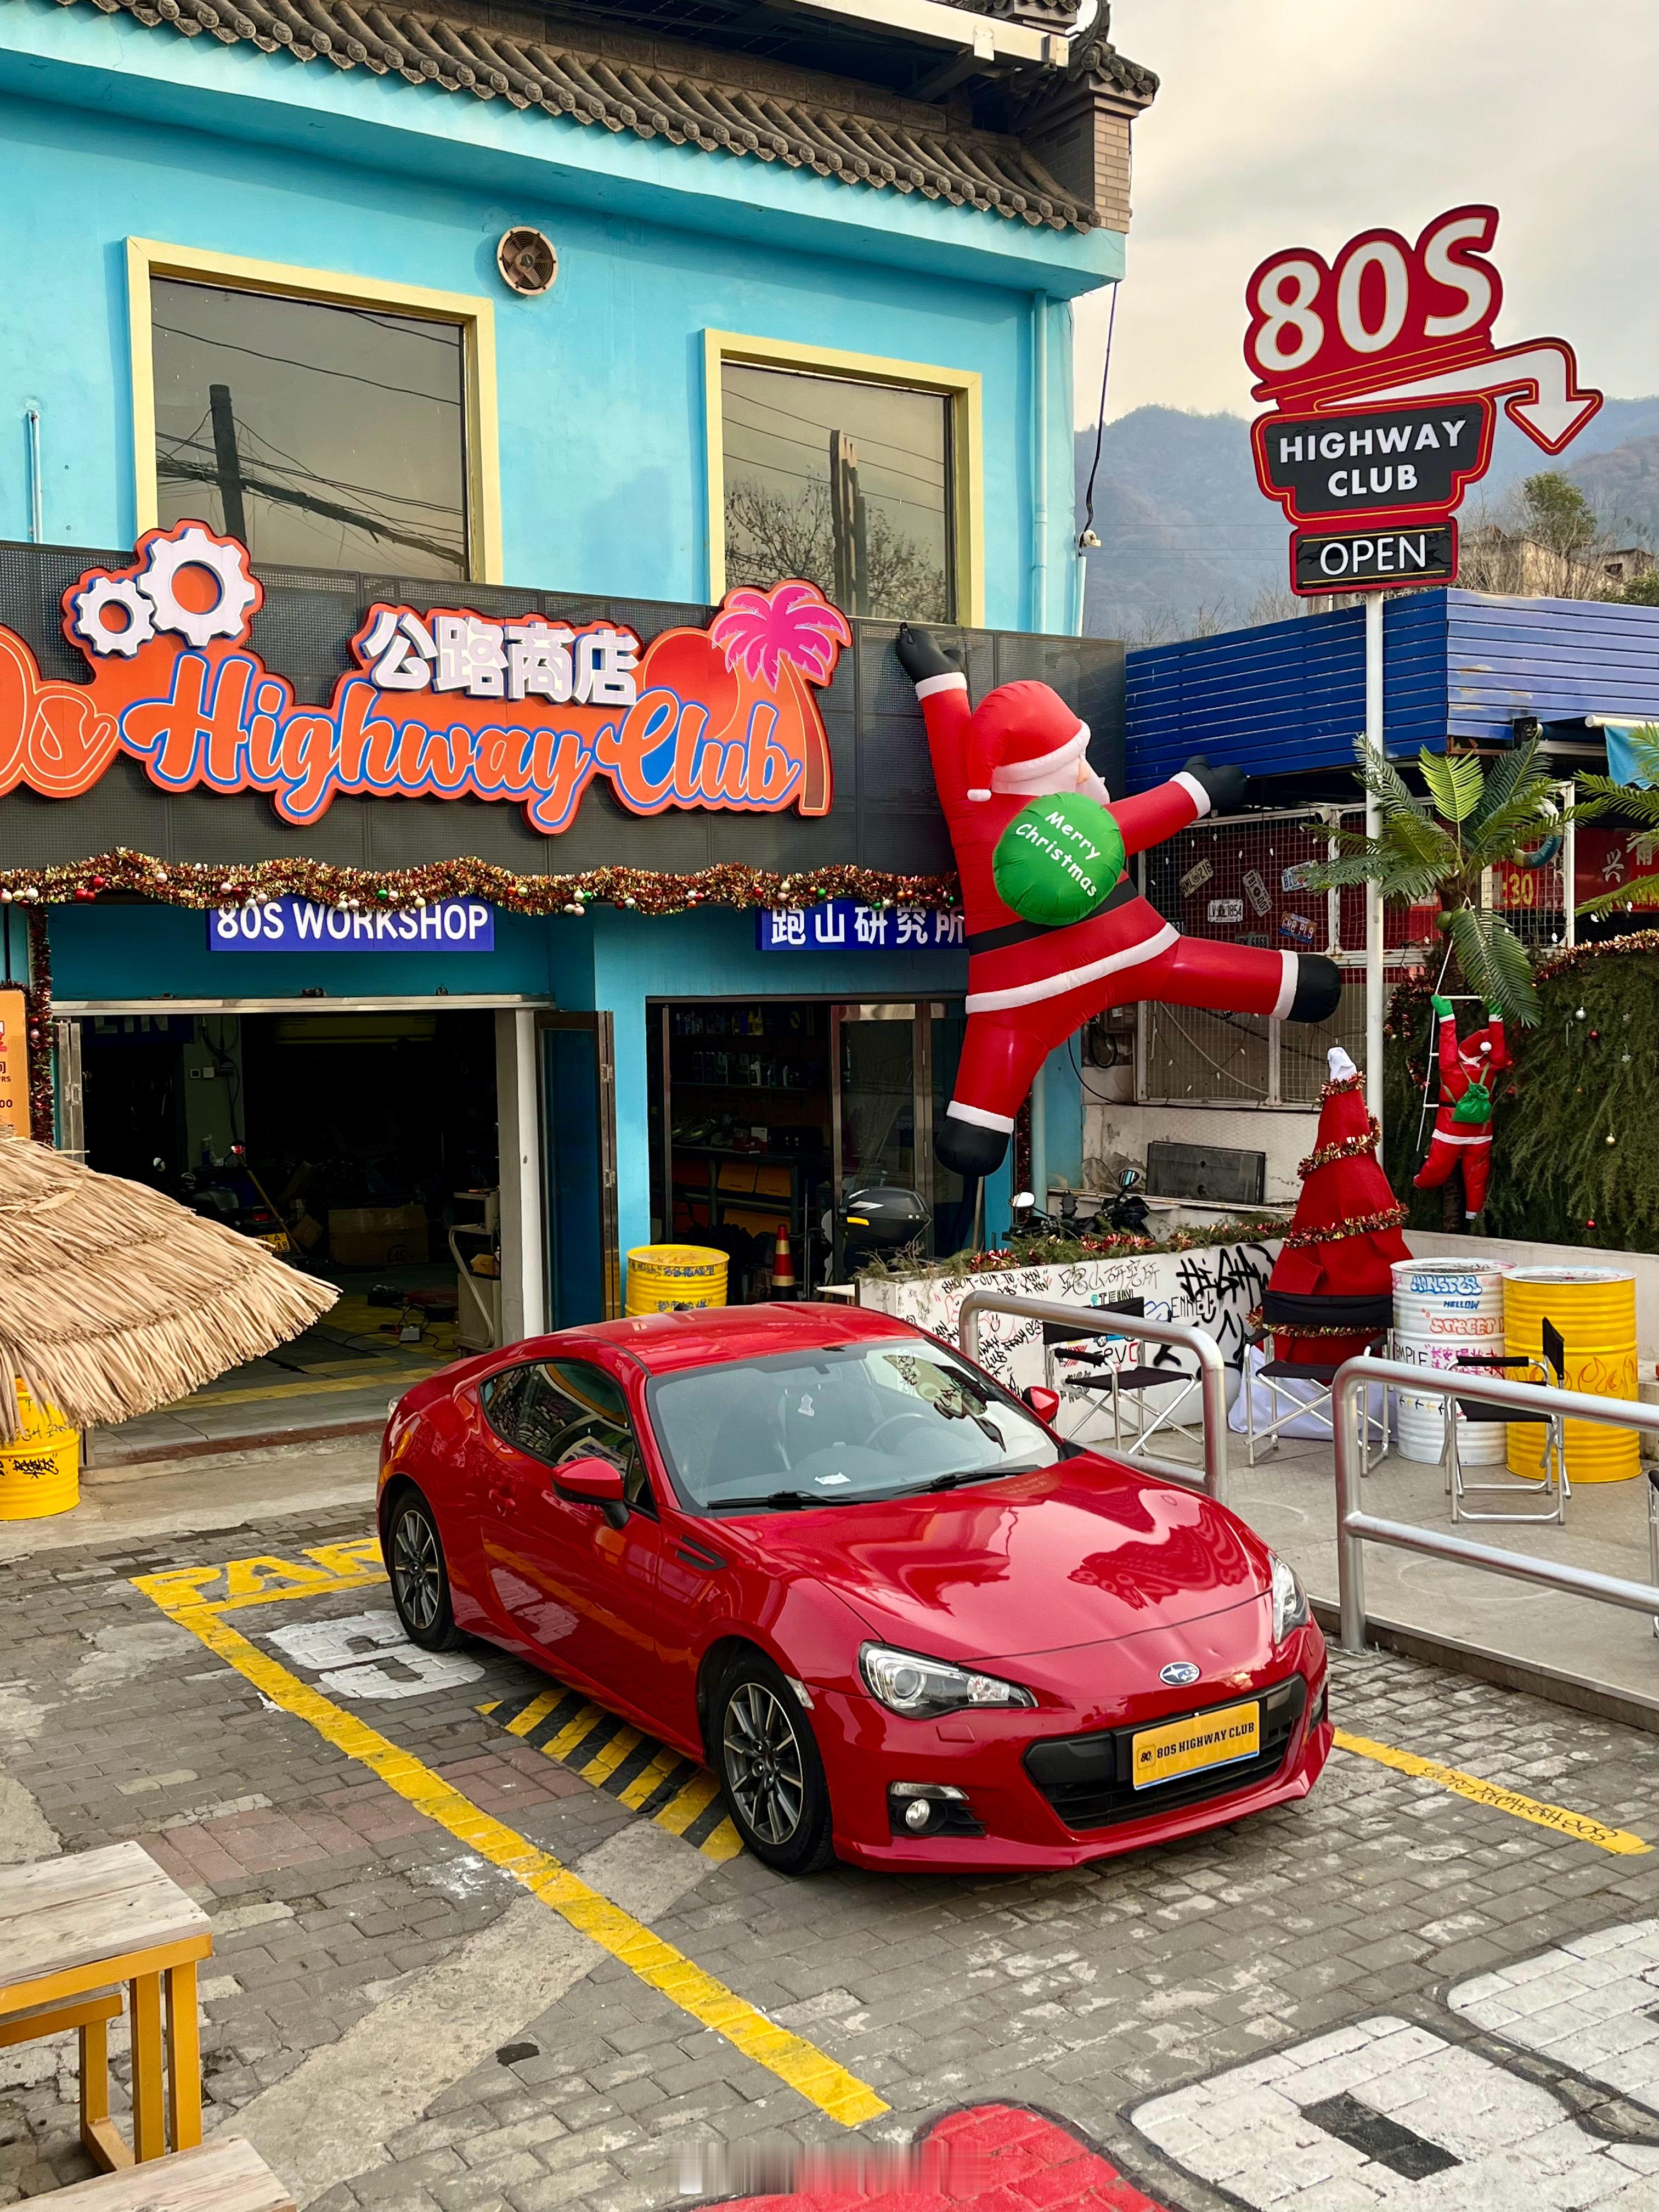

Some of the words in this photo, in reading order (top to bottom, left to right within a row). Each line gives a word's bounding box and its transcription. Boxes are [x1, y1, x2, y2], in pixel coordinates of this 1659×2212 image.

[1255, 217, 1491, 371] 80S
[1280, 420, 1466, 463] HIGHWAY
[1328, 464, 1418, 496] CLUB
[1321, 534, 1426, 575] OPEN
[363, 611, 640, 706] 公路商店
[121, 653, 590, 827] Highway
[596, 687, 801, 807] Club
[1045, 811, 1101, 860] Merry
[1015, 823, 1097, 896] Christmas
[1198, 861, 1212, 879] 216
[218, 902, 284, 940] 80S
[293, 902, 488, 940] WORKSHOP
[771, 906, 964, 944] 跑山研究所
[1227, 904, 1242, 917] 1854
[1444, 1301, 1480, 1310] MELLOW
[1430, 1318, 1496, 1335] STREET
[1156, 1743, 1176, 1759] 80S
[1179, 1729, 1227, 1753] HIGHWAY
[1229, 1722, 1255, 1738] CLUB
